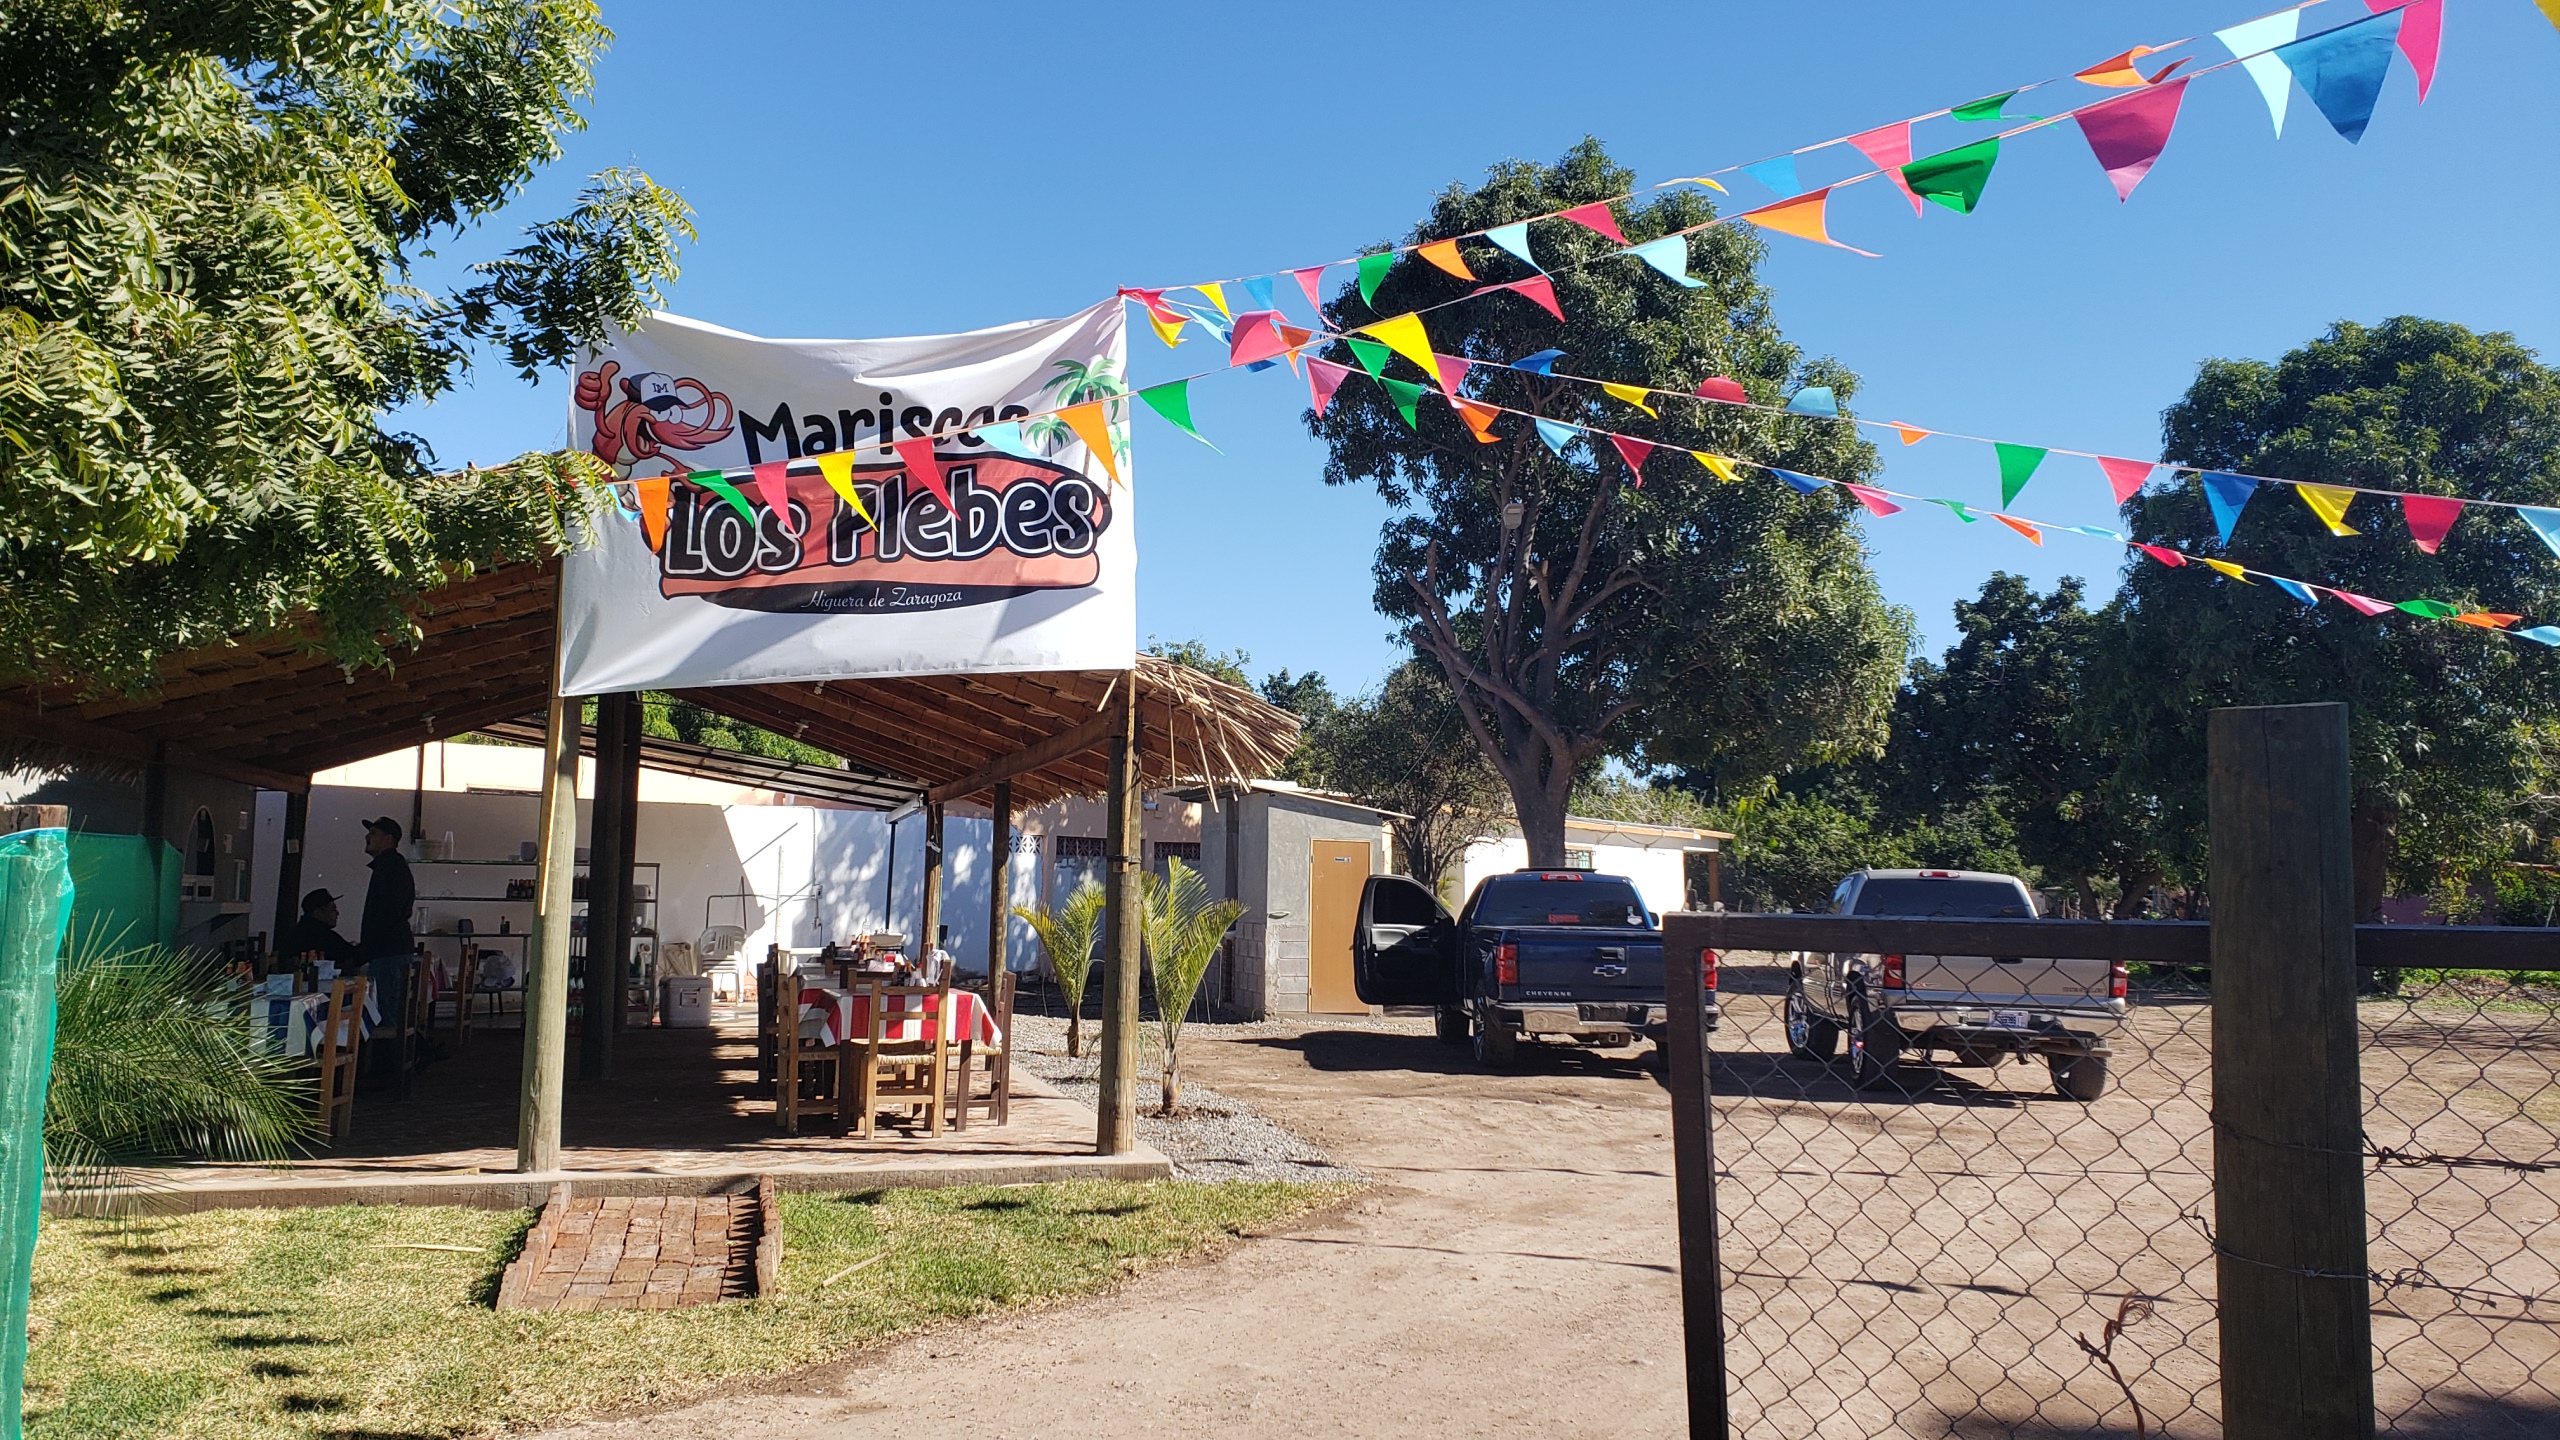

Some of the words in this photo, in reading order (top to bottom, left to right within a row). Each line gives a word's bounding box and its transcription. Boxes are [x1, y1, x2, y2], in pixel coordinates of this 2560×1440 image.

[830, 467, 1096, 565] Plebes
[800, 589, 864, 612] Higuera
[868, 587, 885, 608] de
[889, 586, 963, 609] Zaragoza
